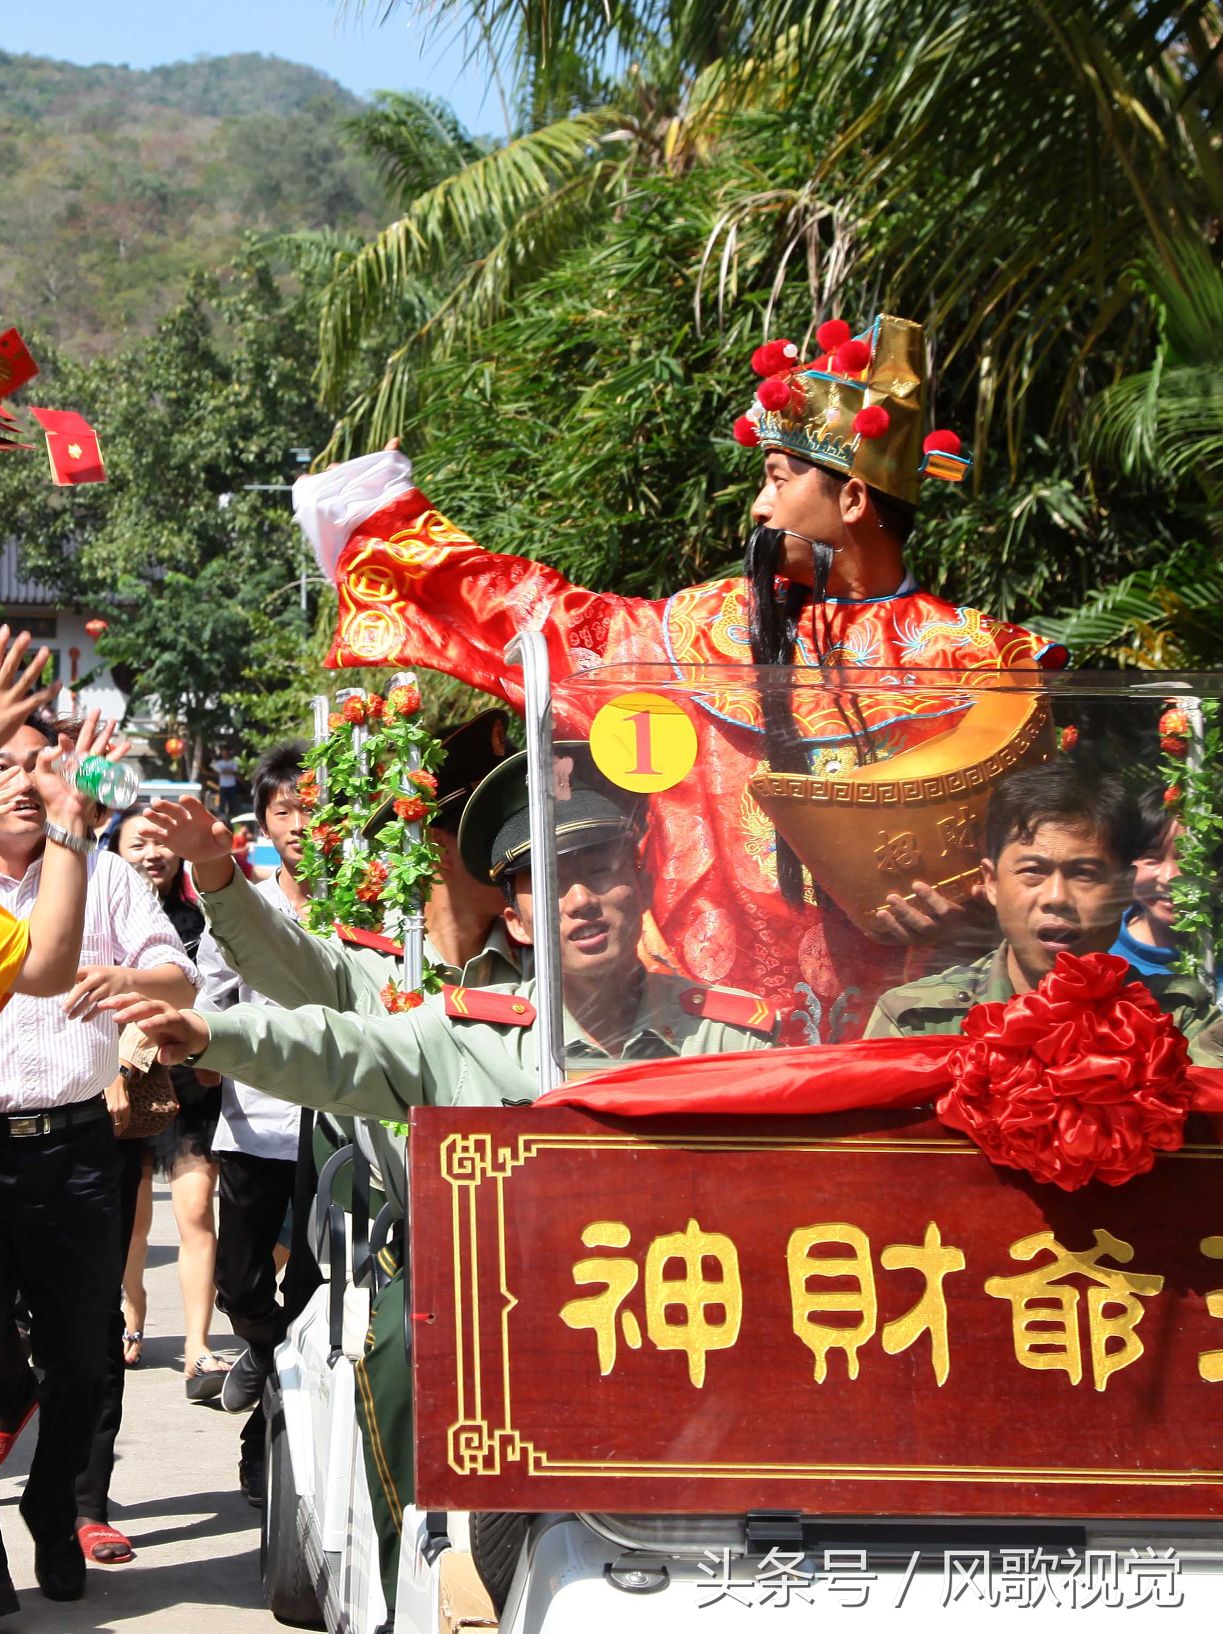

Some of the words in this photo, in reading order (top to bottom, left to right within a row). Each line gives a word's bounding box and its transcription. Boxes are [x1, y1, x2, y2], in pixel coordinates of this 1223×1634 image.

[623, 710, 663, 775] 1
[559, 1218, 1223, 1391] 神財爺
